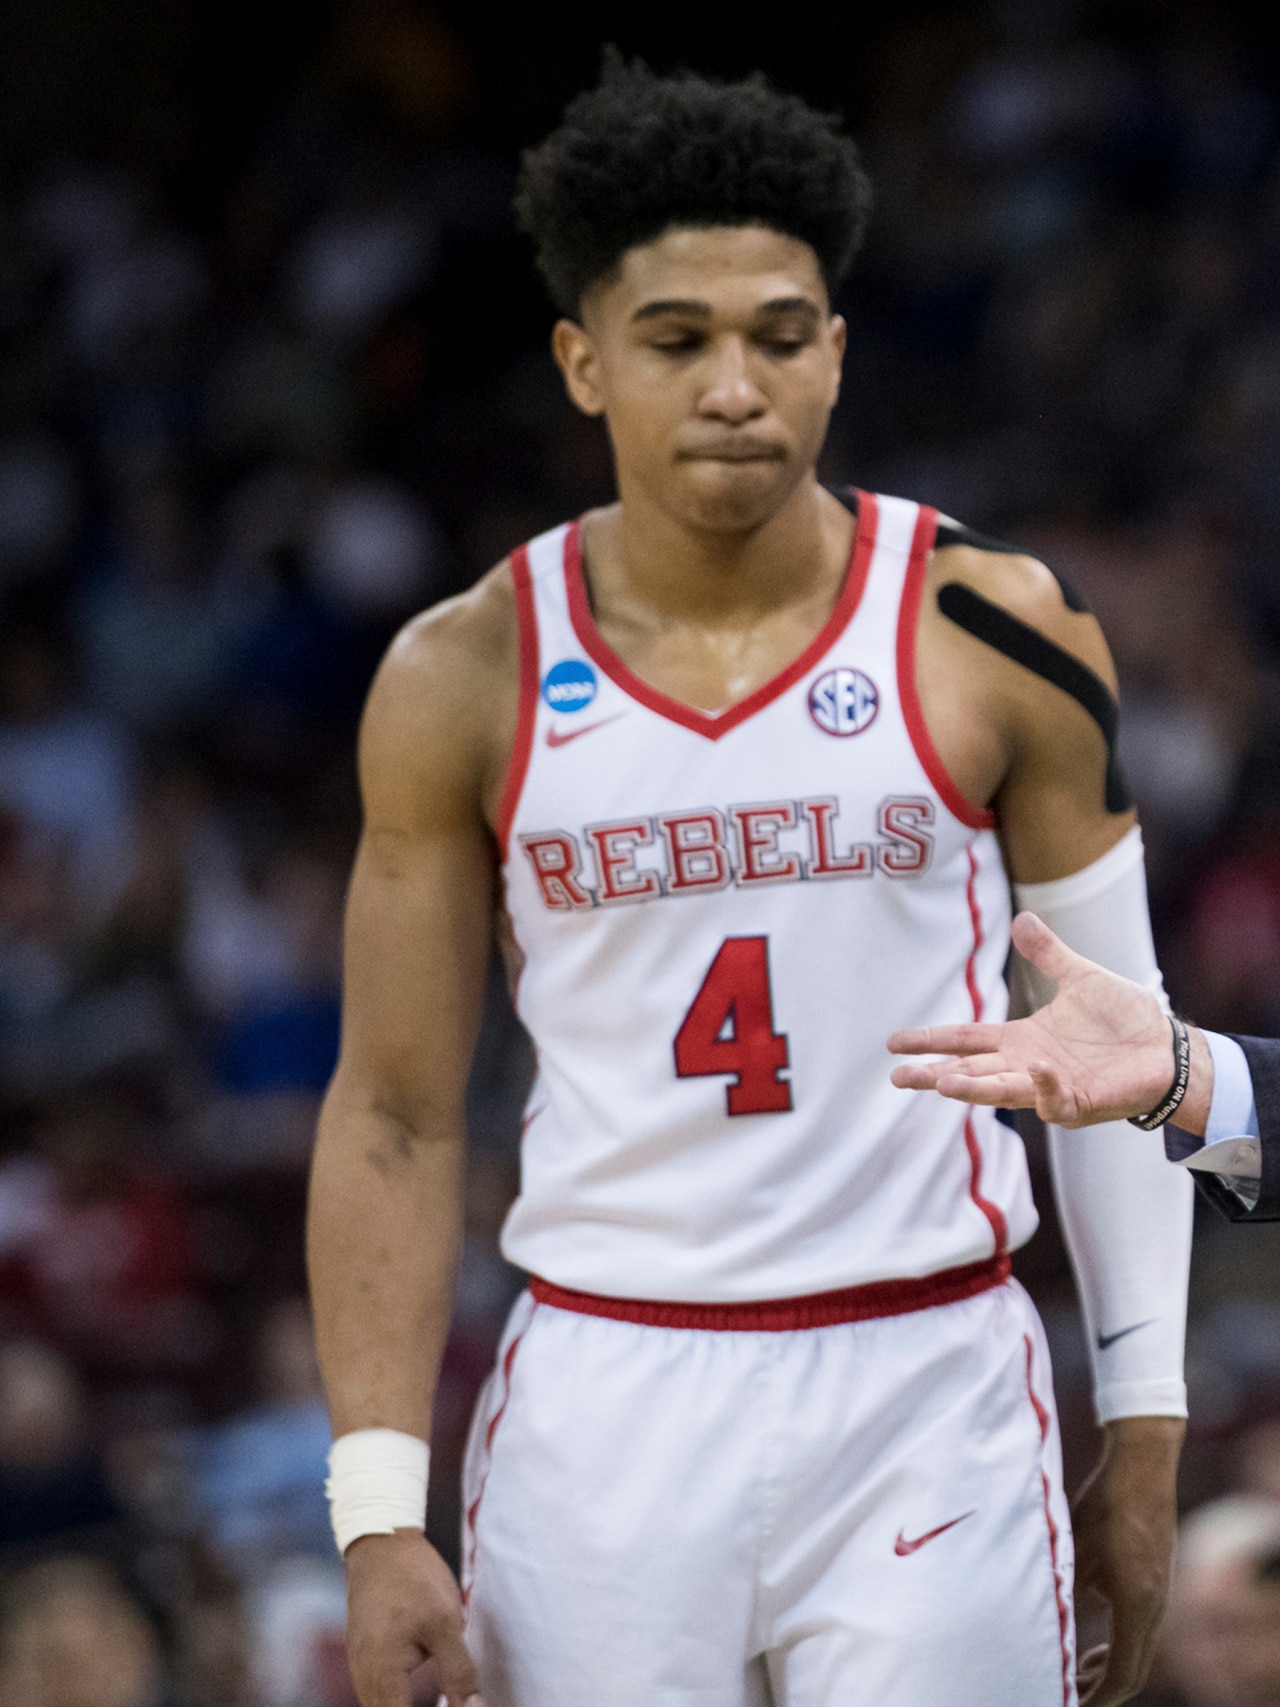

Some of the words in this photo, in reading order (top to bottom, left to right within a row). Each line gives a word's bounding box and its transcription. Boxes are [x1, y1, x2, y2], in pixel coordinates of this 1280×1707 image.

[810, 670, 877, 733] SEC
[518, 795, 936, 911] REBELS
[673, 935, 794, 1117] 4
[1179, 1040, 1189, 1058] Play
[1172, 1085, 1185, 1101] ON
[1179, 1066, 1189, 1085] Live
